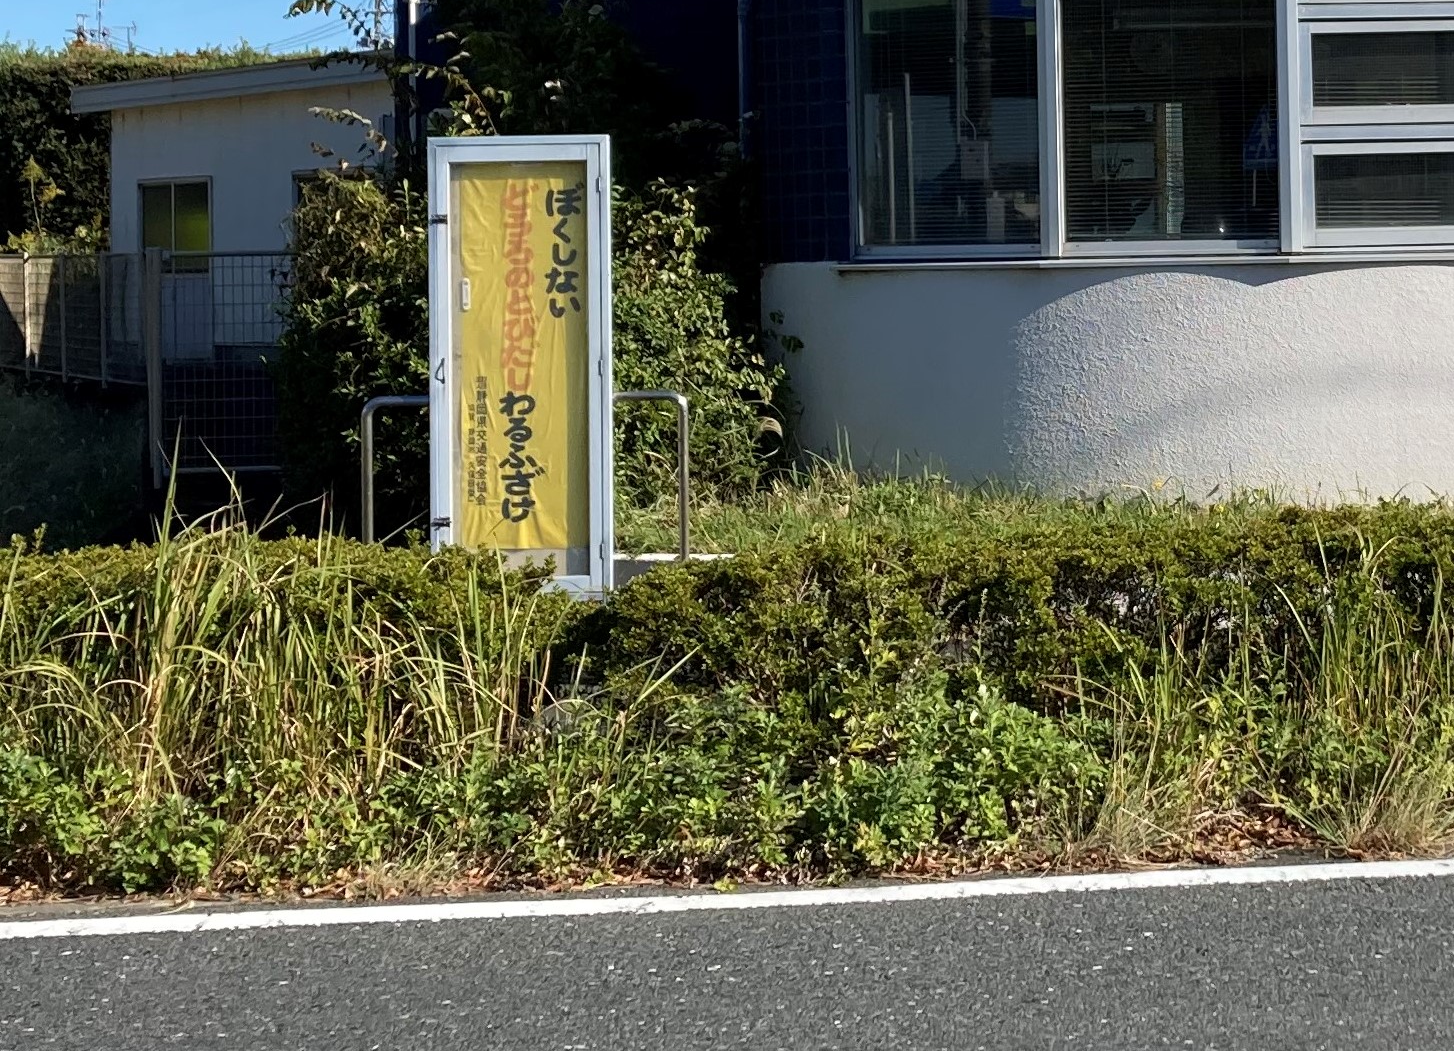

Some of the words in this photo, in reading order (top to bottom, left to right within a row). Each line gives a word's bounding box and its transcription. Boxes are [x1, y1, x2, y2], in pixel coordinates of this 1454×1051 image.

[545, 182, 584, 318] ぼくしない
